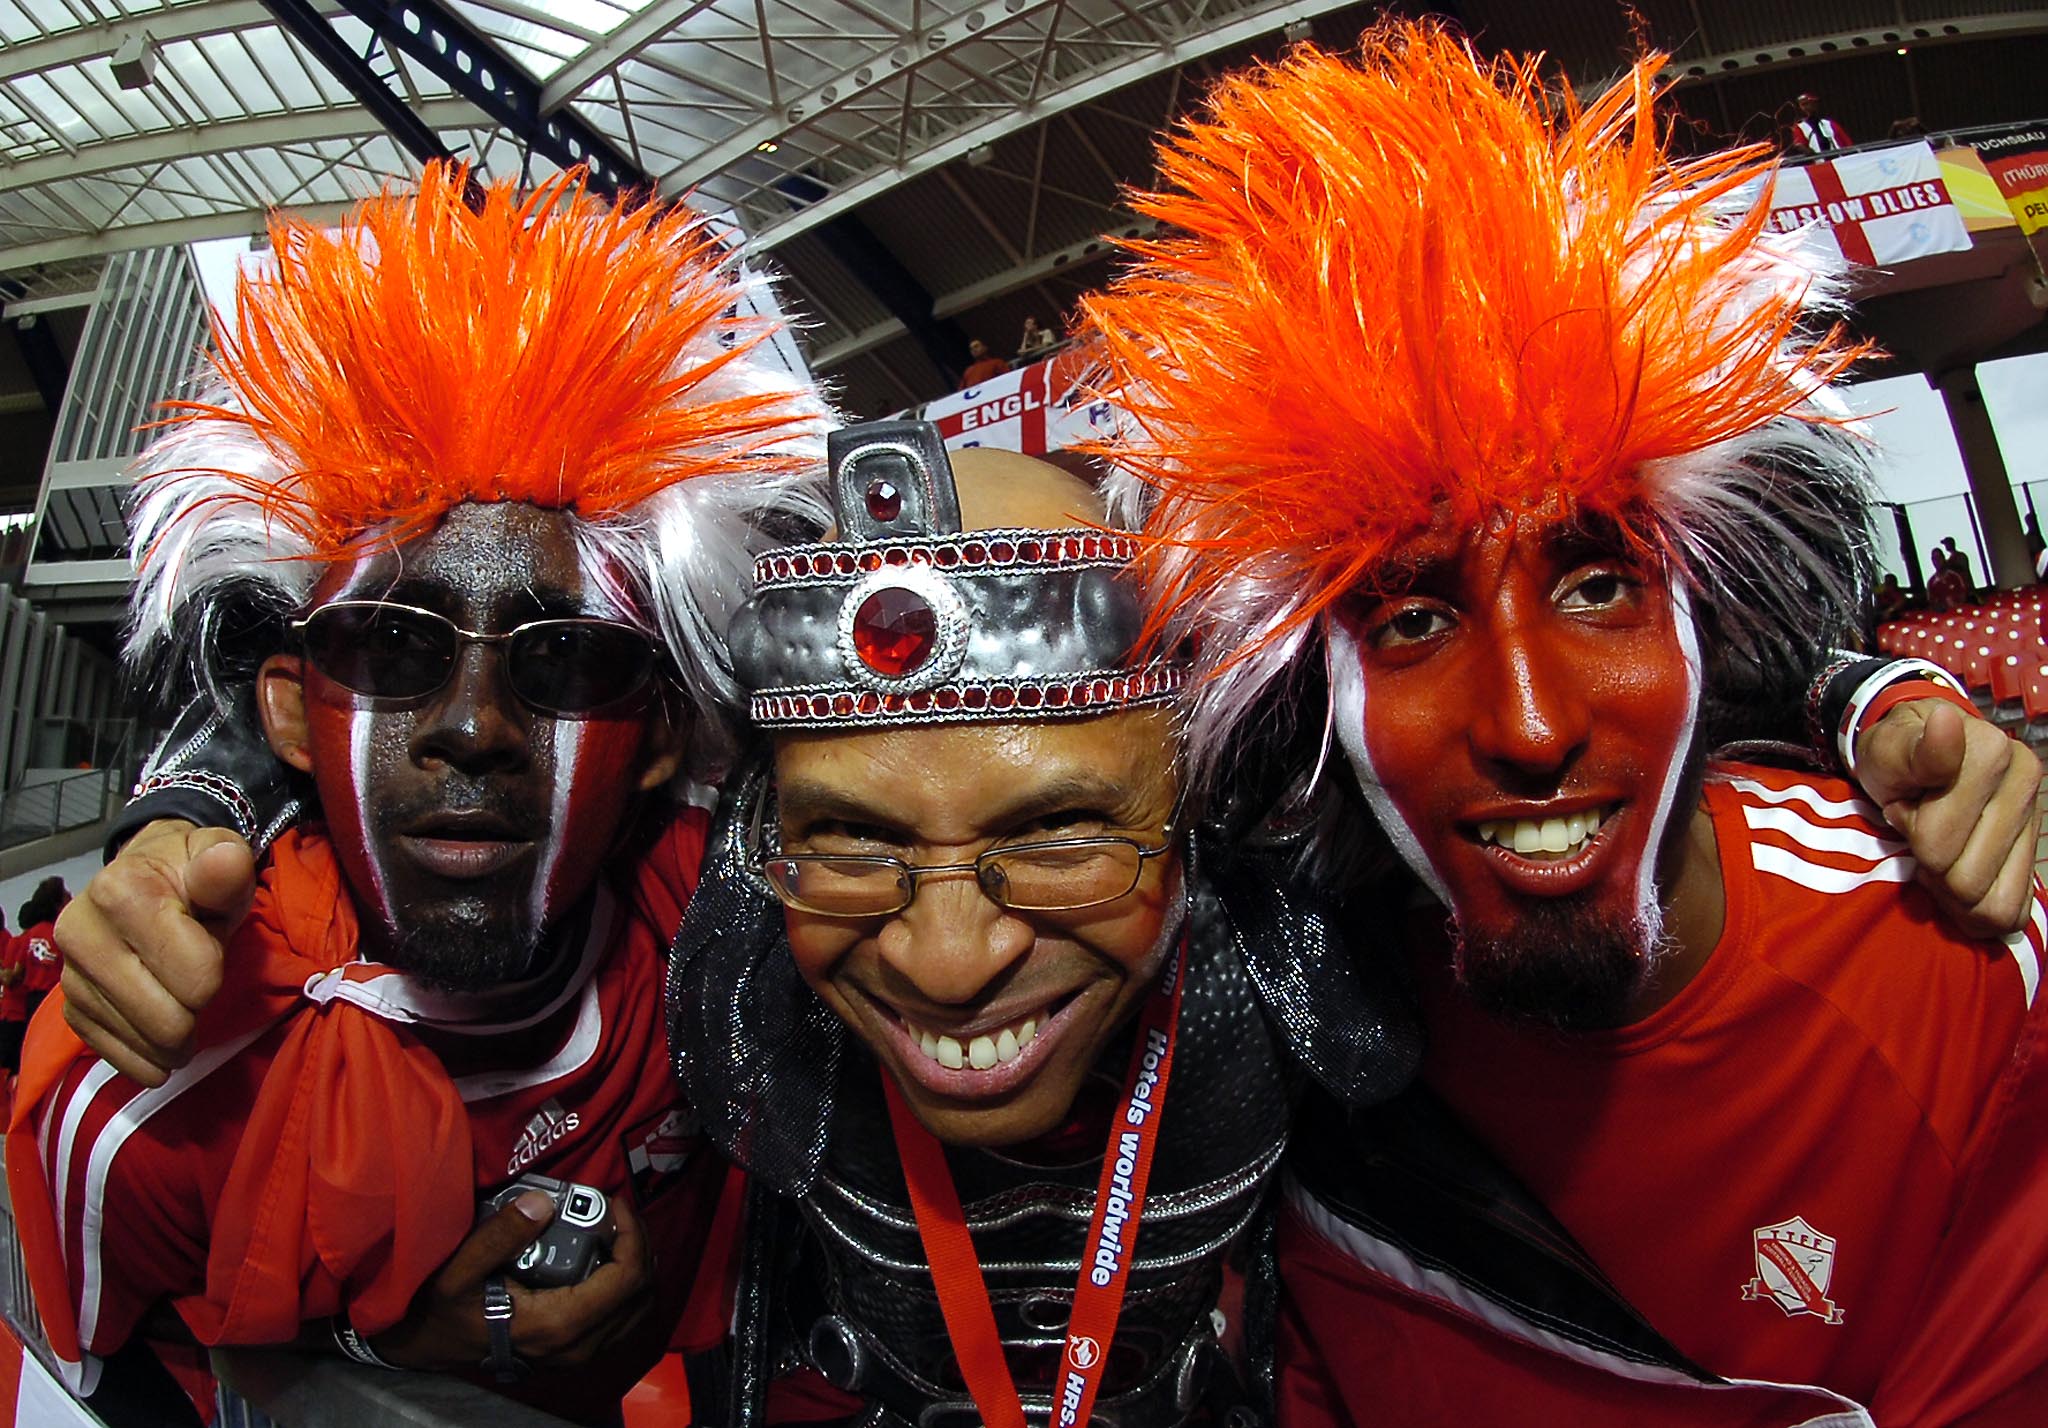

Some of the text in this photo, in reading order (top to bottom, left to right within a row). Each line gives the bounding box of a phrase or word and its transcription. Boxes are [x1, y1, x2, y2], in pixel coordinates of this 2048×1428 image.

[1869, 183, 1941, 216] BLUES
[961, 390, 1046, 431] ENGL
[507, 1112, 580, 1175] adidas
[1090, 1027, 1167, 1287] Hotels worldwide
